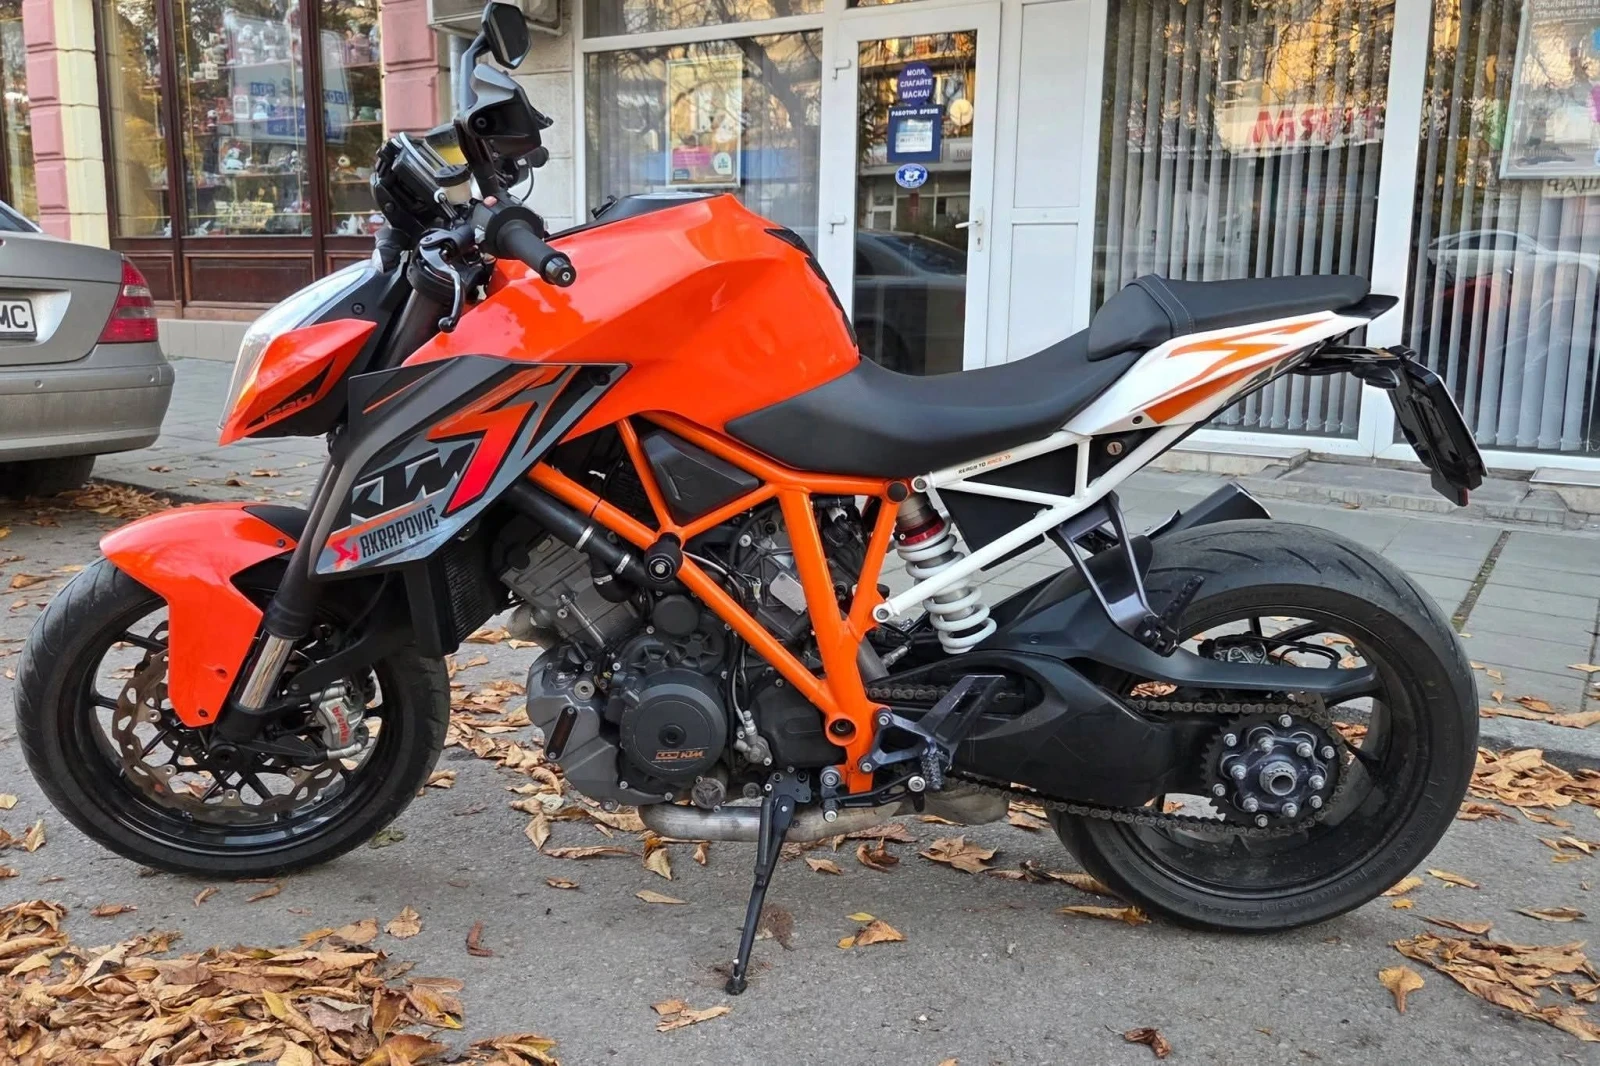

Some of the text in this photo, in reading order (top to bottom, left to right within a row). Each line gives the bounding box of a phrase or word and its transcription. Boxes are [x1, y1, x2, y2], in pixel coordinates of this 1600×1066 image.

[900, 78, 932, 87] СЛАГАЙТЕ
[891, 109, 917, 117] РАБОТНО
[335, 442, 475, 531] KTM
[360, 504, 439, 558] AKRAPOVIČ
